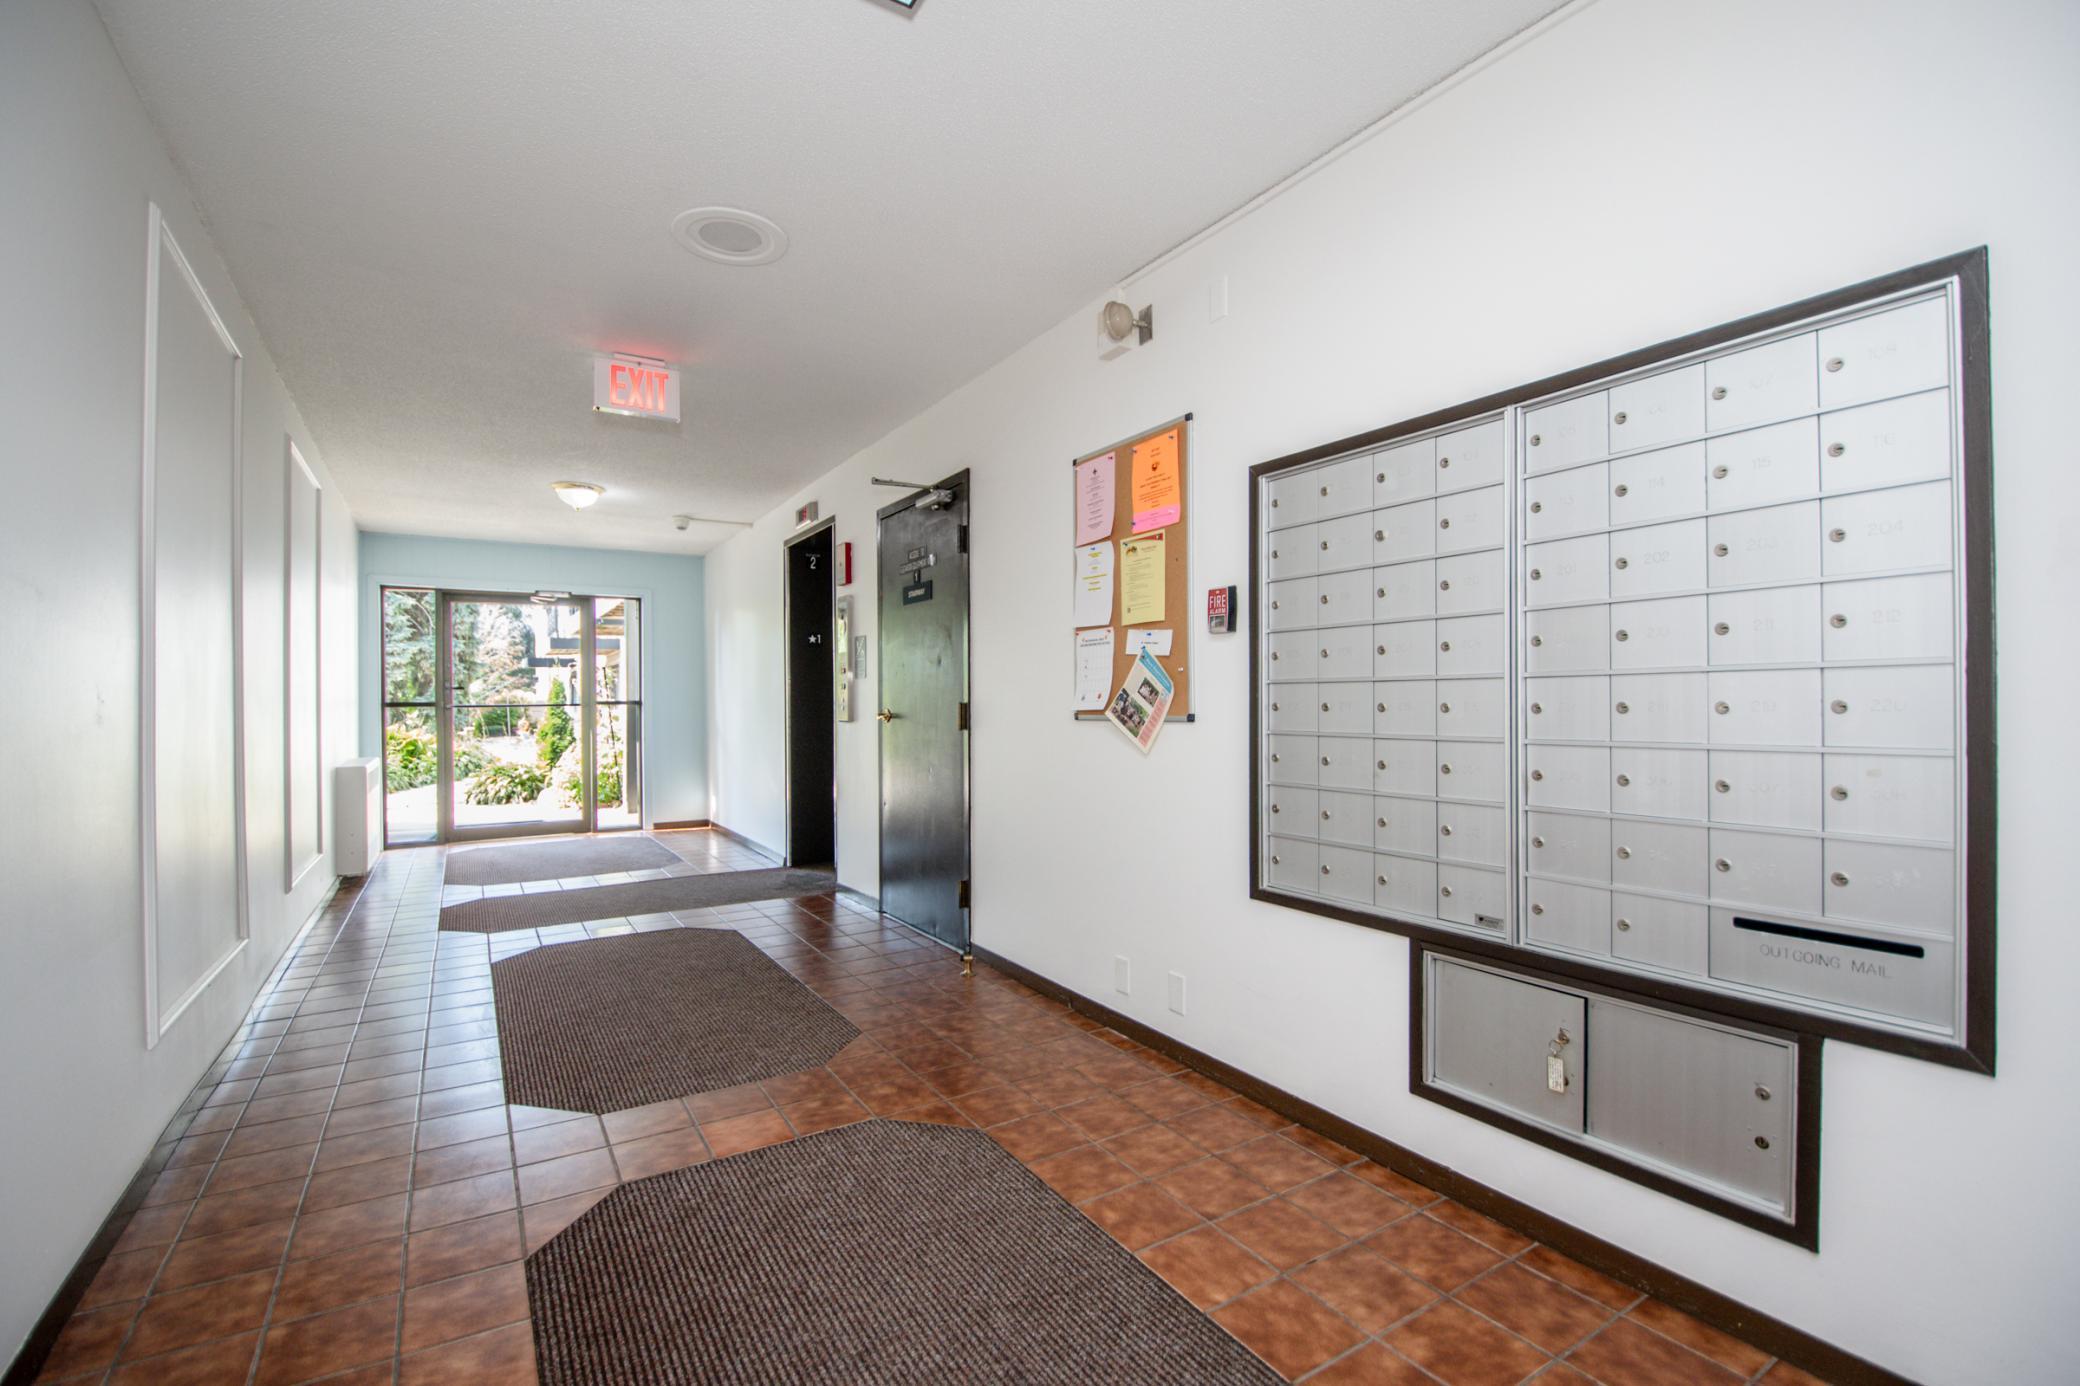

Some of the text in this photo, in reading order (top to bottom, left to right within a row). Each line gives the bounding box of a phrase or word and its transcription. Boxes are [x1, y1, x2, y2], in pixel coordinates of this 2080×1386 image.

[610, 364, 669, 412] EXIT
[1867, 519, 1905, 538] 204
[810, 556, 817, 570] 2
[1643, 550, 1671, 566] 202
[1209, 594, 1227, 609] FIRE
[1759, 942, 1894, 979] OUTGOING MAIL
